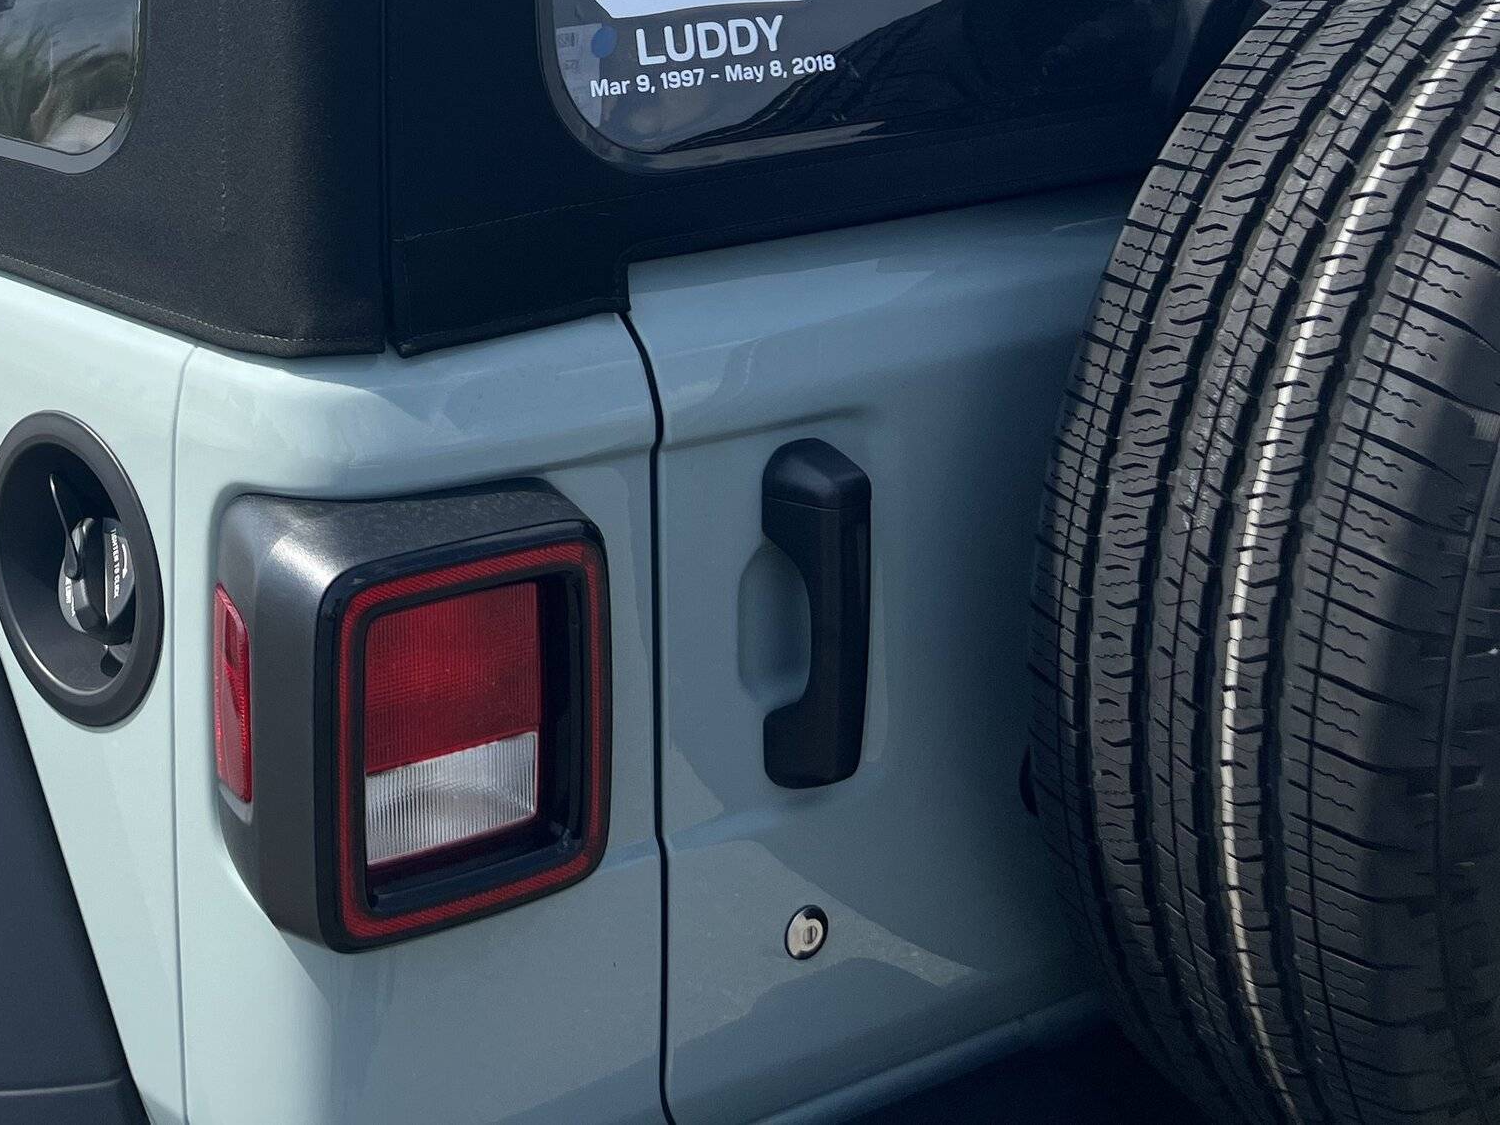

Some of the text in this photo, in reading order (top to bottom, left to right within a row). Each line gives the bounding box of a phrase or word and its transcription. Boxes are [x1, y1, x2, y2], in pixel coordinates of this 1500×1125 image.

[635, 14, 784, 66] LUDDY
[589, 78, 630, 98] Mar
[636, 74, 656, 94] 9,
[660, 68, 705, 90] 1997
[725, 63, 765, 83] May
[769, 59, 788, 79] 8,
[791, 53, 837, 75] 2018
